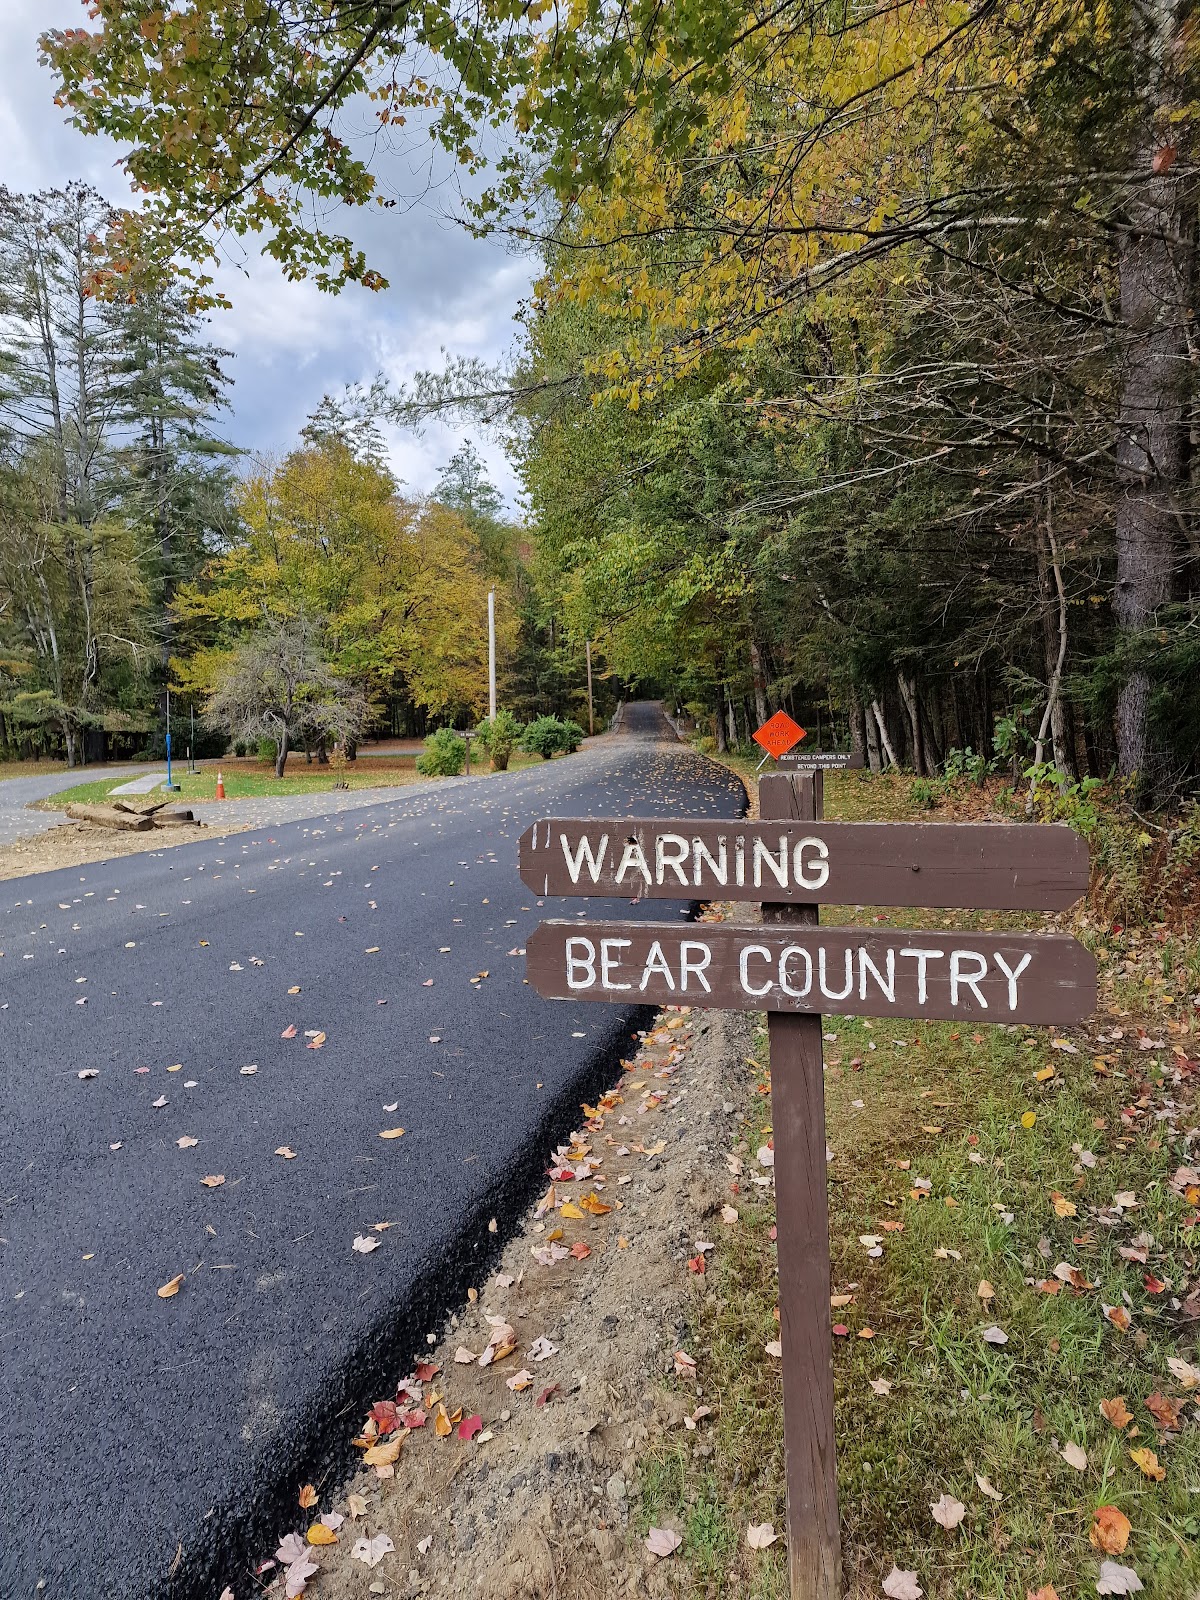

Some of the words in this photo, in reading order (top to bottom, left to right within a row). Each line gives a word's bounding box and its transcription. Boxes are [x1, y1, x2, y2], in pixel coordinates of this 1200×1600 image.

[559, 833, 831, 890] WARNING
[565, 936, 712, 993] BEAR
[739, 944, 1032, 1011] COUNTRY
